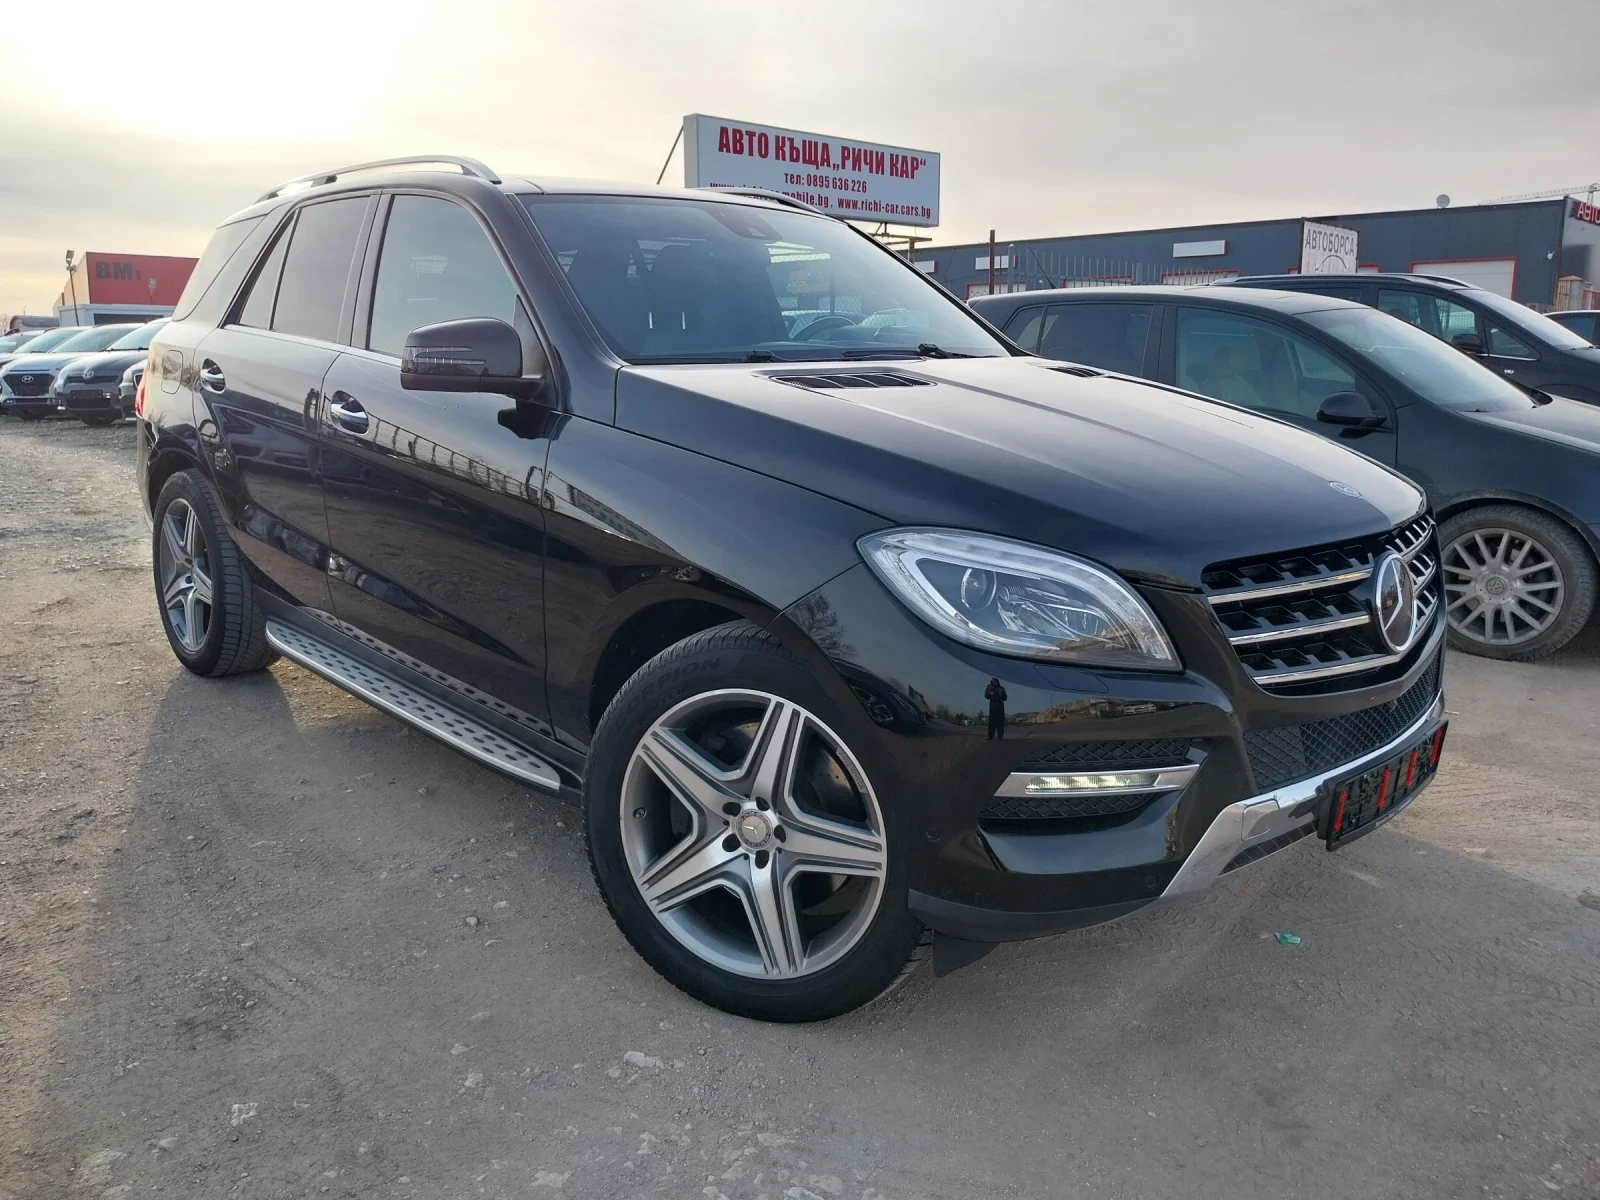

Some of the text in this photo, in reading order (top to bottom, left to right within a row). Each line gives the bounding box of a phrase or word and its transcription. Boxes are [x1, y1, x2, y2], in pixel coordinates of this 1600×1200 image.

[718, 126, 769, 159] АВТО
[774, 135, 831, 170] КЪЩА
[784, 173, 867, 193] тел: 0895 636 226
[837, 197, 931, 219] www.richi-car.cars.bg
[1305, 228, 1354, 256] АВТОБОРСА
